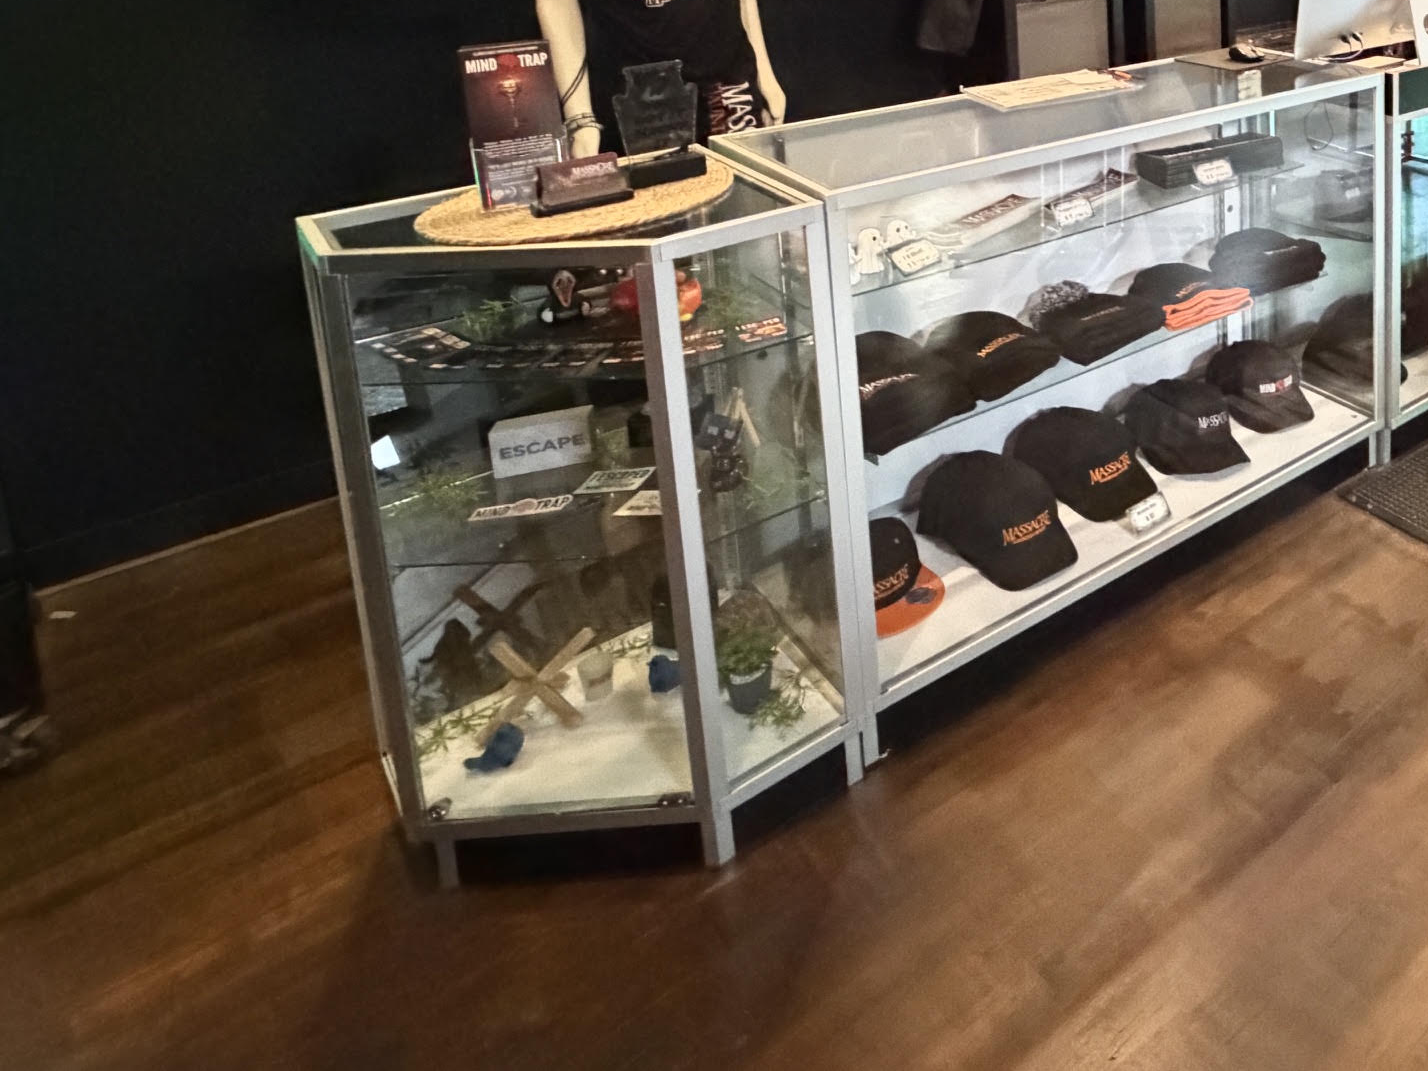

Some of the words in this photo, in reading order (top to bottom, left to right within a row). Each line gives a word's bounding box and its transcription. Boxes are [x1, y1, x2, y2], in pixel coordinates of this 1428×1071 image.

[464, 57, 498, 75] MIND
[517, 51, 548, 68] TRAP
[499, 433, 585, 460] ESCAPE
[534, 495, 572, 510] TRAP
